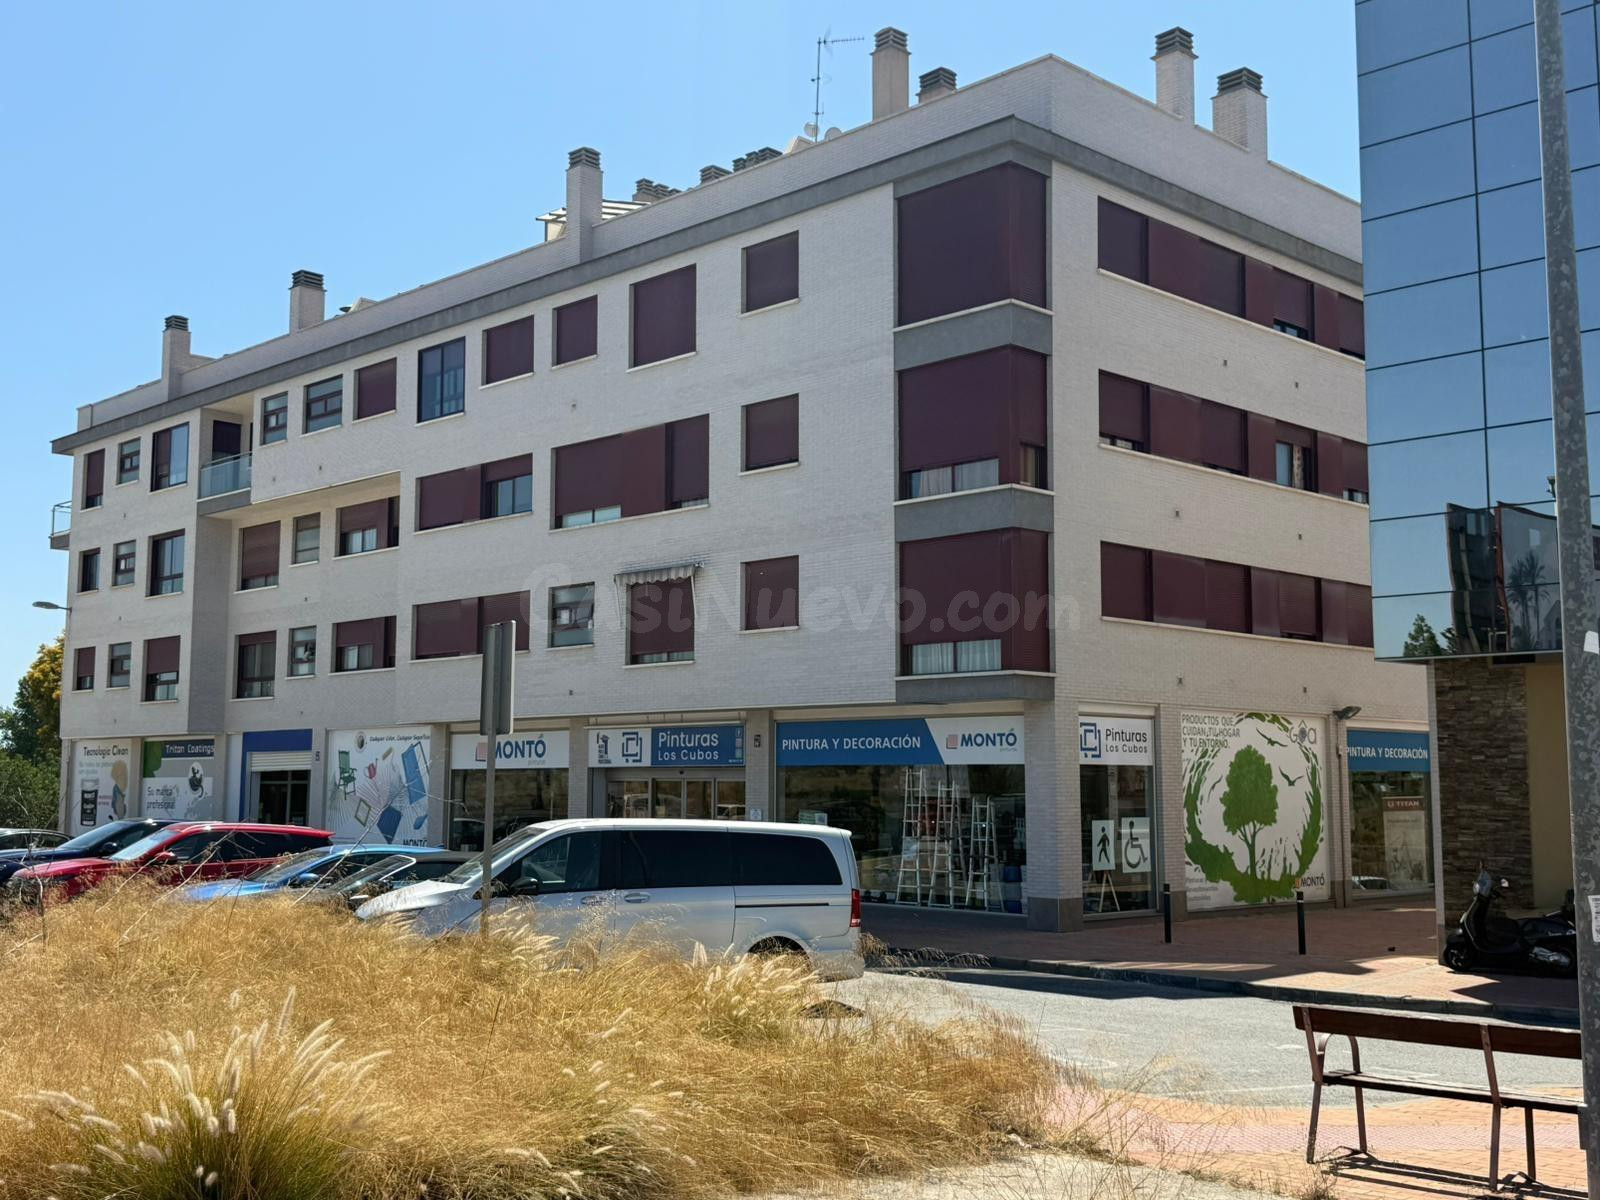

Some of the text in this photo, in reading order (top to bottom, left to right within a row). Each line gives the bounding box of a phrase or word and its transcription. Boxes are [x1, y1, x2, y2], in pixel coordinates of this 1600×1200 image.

[1182, 714, 1234, 727] PRODUCTOS QUE
[960, 728, 1018, 748] MONTÓ
[1105, 728, 1148, 743] Pinturas
[1182, 726, 1241, 738] CUIDAN TU HOGAR
[658, 731, 719, 749] Pinturas
[782, 734, 921, 751] PINTURA Y DECORACIÓN
[1182, 737, 1188, 747] Y
[1189, 737, 1198, 748] TU
[658, 749, 719, 761] Los Cubos
[1105, 744, 1148, 754] Los Cubos
[1347, 746, 1428, 760] PINTURA Y DECORACIÓN
[1396, 800, 1420, 808] TITAN
[1300, 872, 1325, 887] MONTÓ
